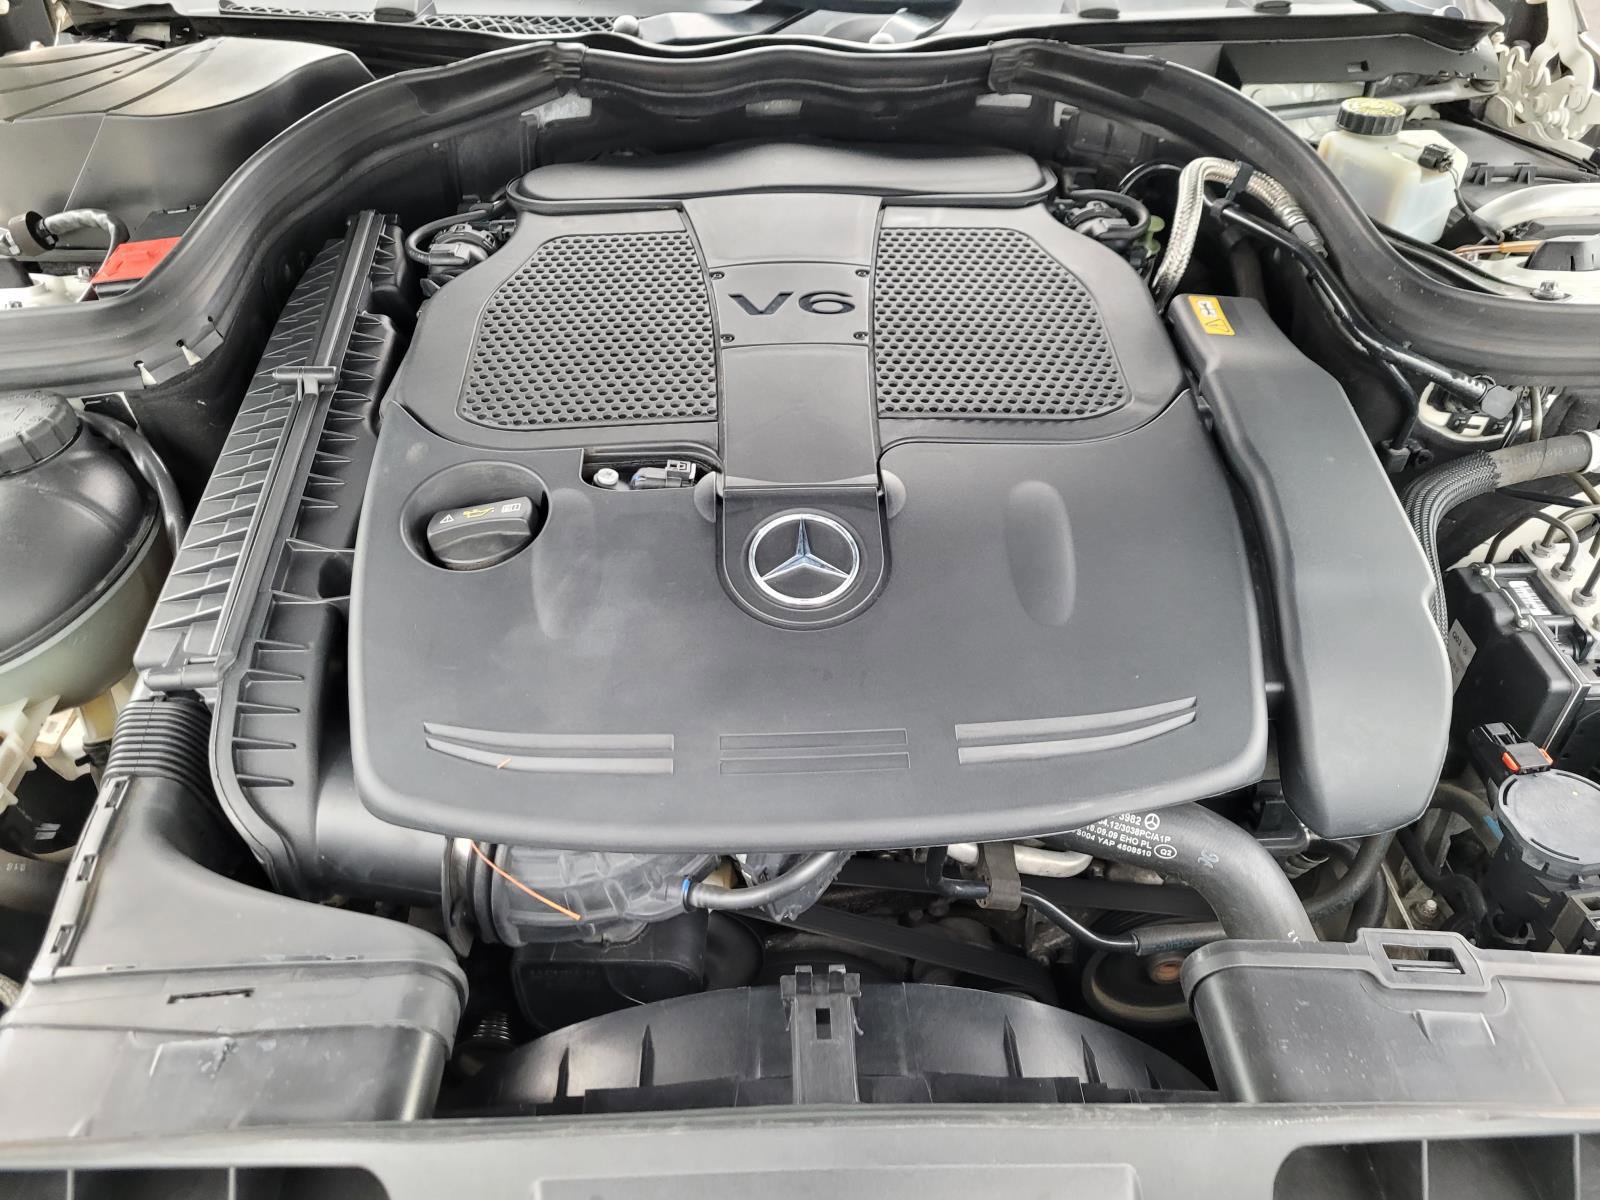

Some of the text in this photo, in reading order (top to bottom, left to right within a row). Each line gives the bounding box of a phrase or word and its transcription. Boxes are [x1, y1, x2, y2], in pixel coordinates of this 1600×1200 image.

[728, 290, 856, 316] V6
[1097, 836, 1116, 846] YAP
[1119, 833, 1139, 845] EHO
[1140, 839, 1153, 850] PL
[1160, 848, 1172, 857] Q2
